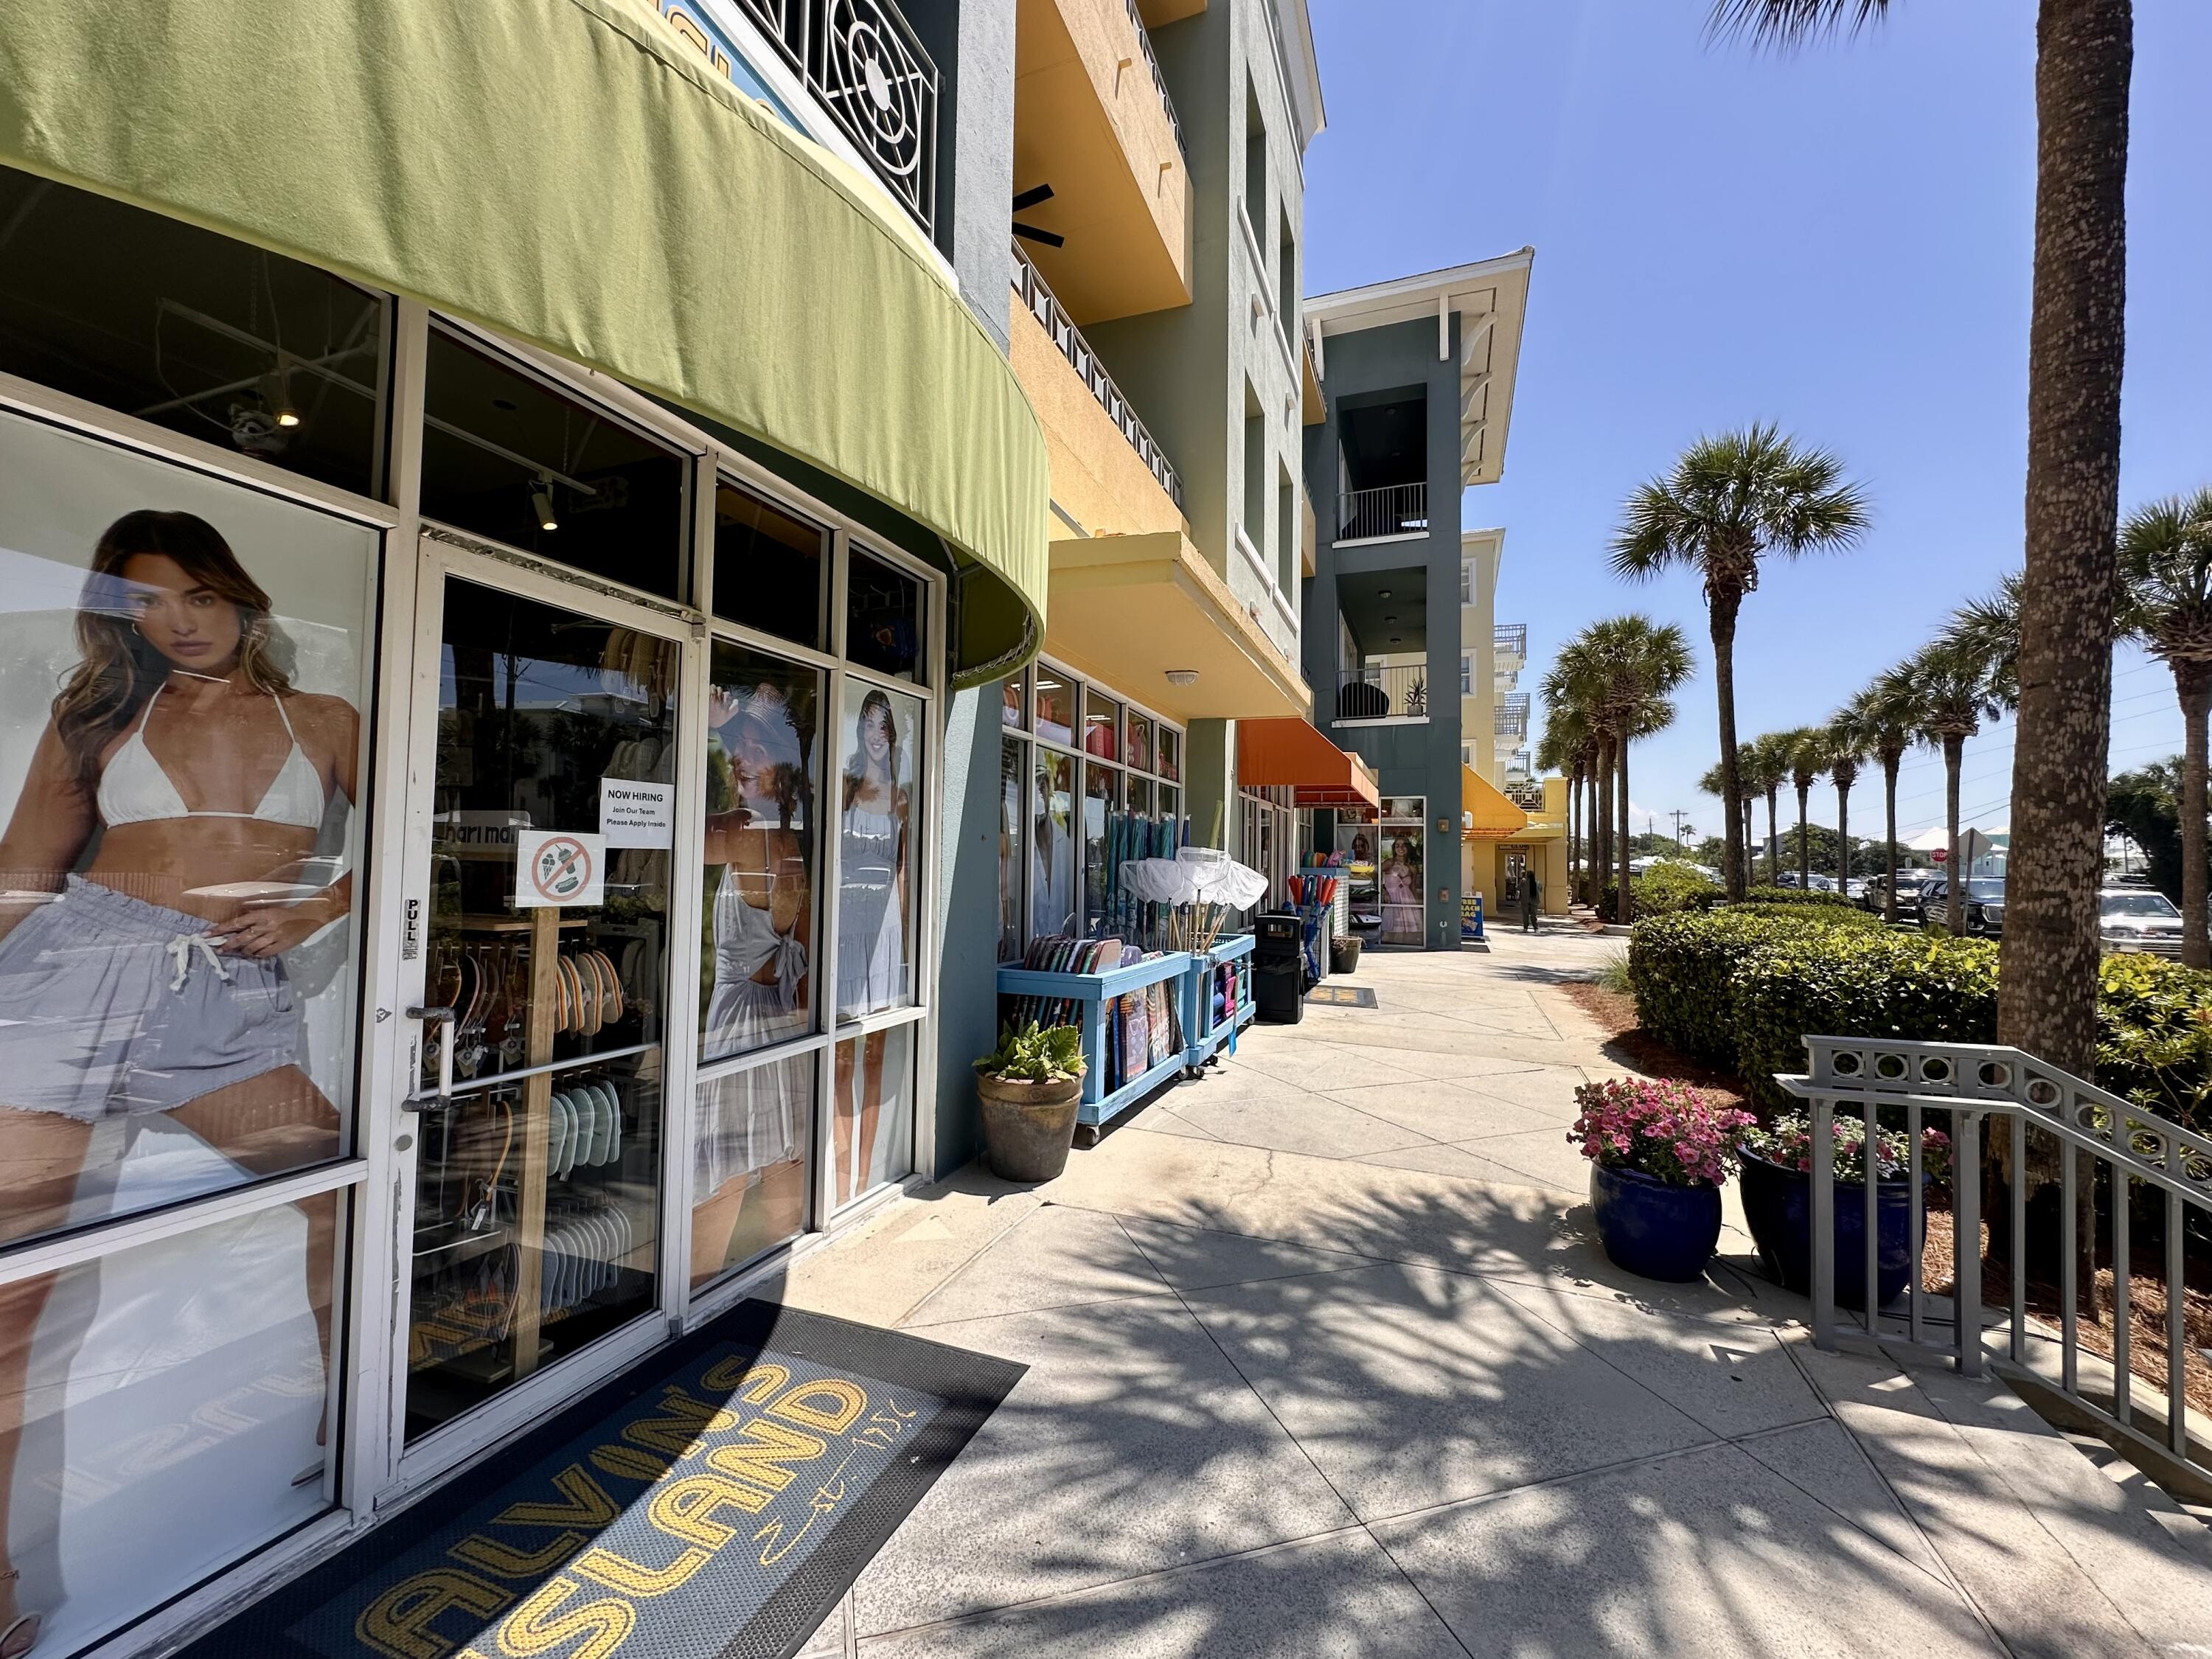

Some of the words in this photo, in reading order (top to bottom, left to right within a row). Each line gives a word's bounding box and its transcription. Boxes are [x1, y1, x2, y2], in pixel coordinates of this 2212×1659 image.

[608, 790, 631, 800] NOW
[633, 792, 664, 802] HIRING
[484, 825, 516, 844] ma
[408, 900, 418, 941] PULL
[455, 1378, 868, 1659] SLAND
